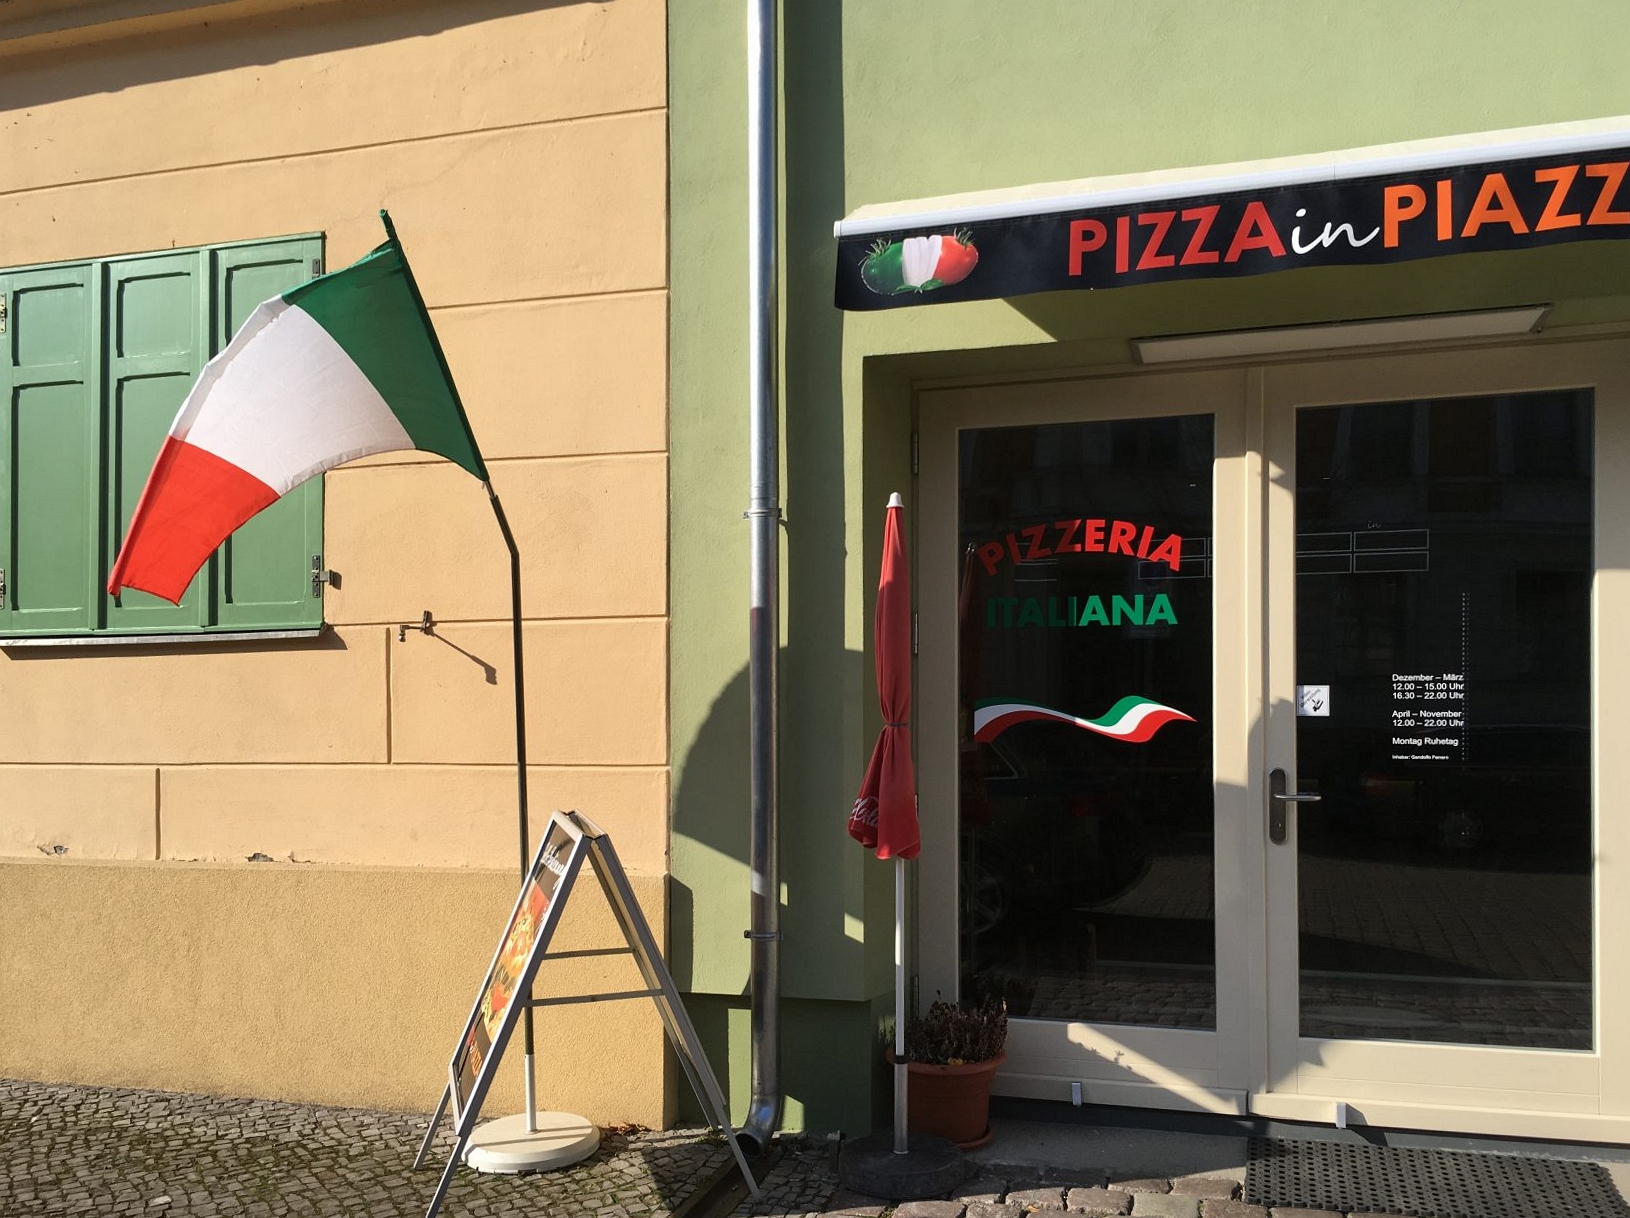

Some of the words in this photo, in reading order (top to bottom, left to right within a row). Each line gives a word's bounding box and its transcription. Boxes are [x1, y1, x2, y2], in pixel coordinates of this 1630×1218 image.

[1067, 201, 1288, 277] PIZZA
[1289, 207, 1381, 256] in
[976, 518, 1182, 576] PIZZERIA
[986, 593, 1179, 628] ITALIANA
[1392, 710, 1411, 718] April
[1420, 710, 1462, 718] November
[1393, 719, 1415, 727] 12.00
[1424, 719, 1447, 727] 22.00
[1449, 719, 1464, 727] Uhr
[1392, 737, 1423, 746] Montag
[1424, 737, 1459, 746] Ruhetag
